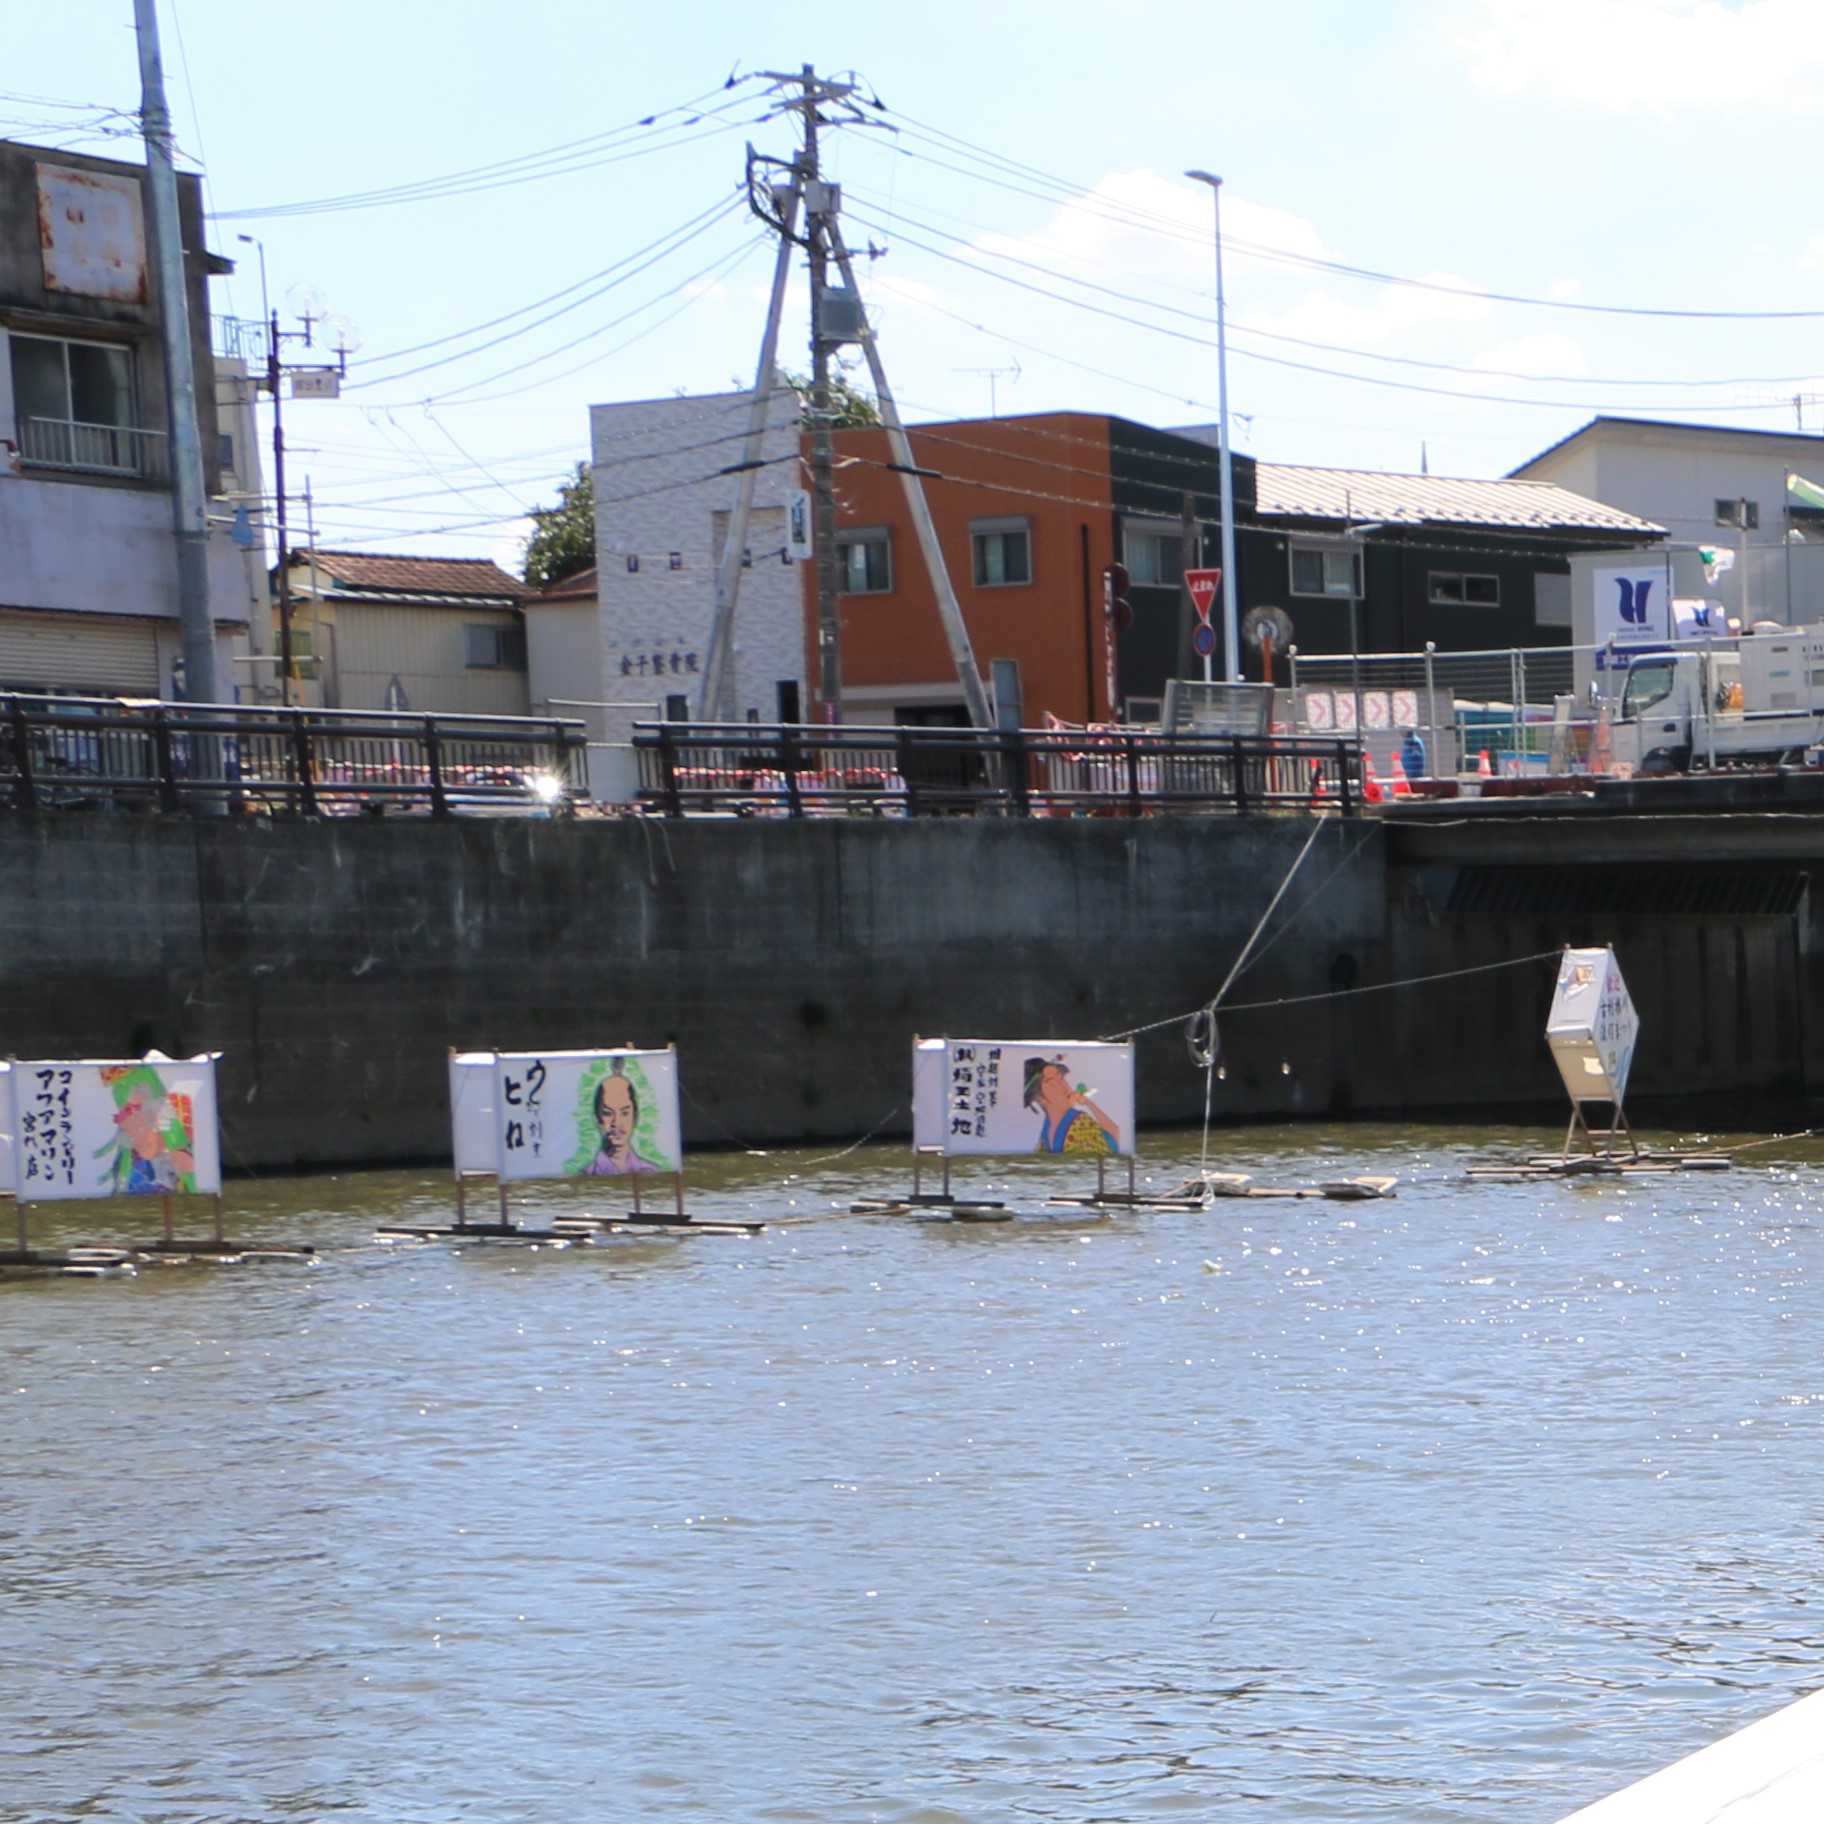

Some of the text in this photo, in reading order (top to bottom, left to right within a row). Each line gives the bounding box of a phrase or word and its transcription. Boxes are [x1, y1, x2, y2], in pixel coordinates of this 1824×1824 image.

[58, 1070, 75, 1185] コインランドリー
